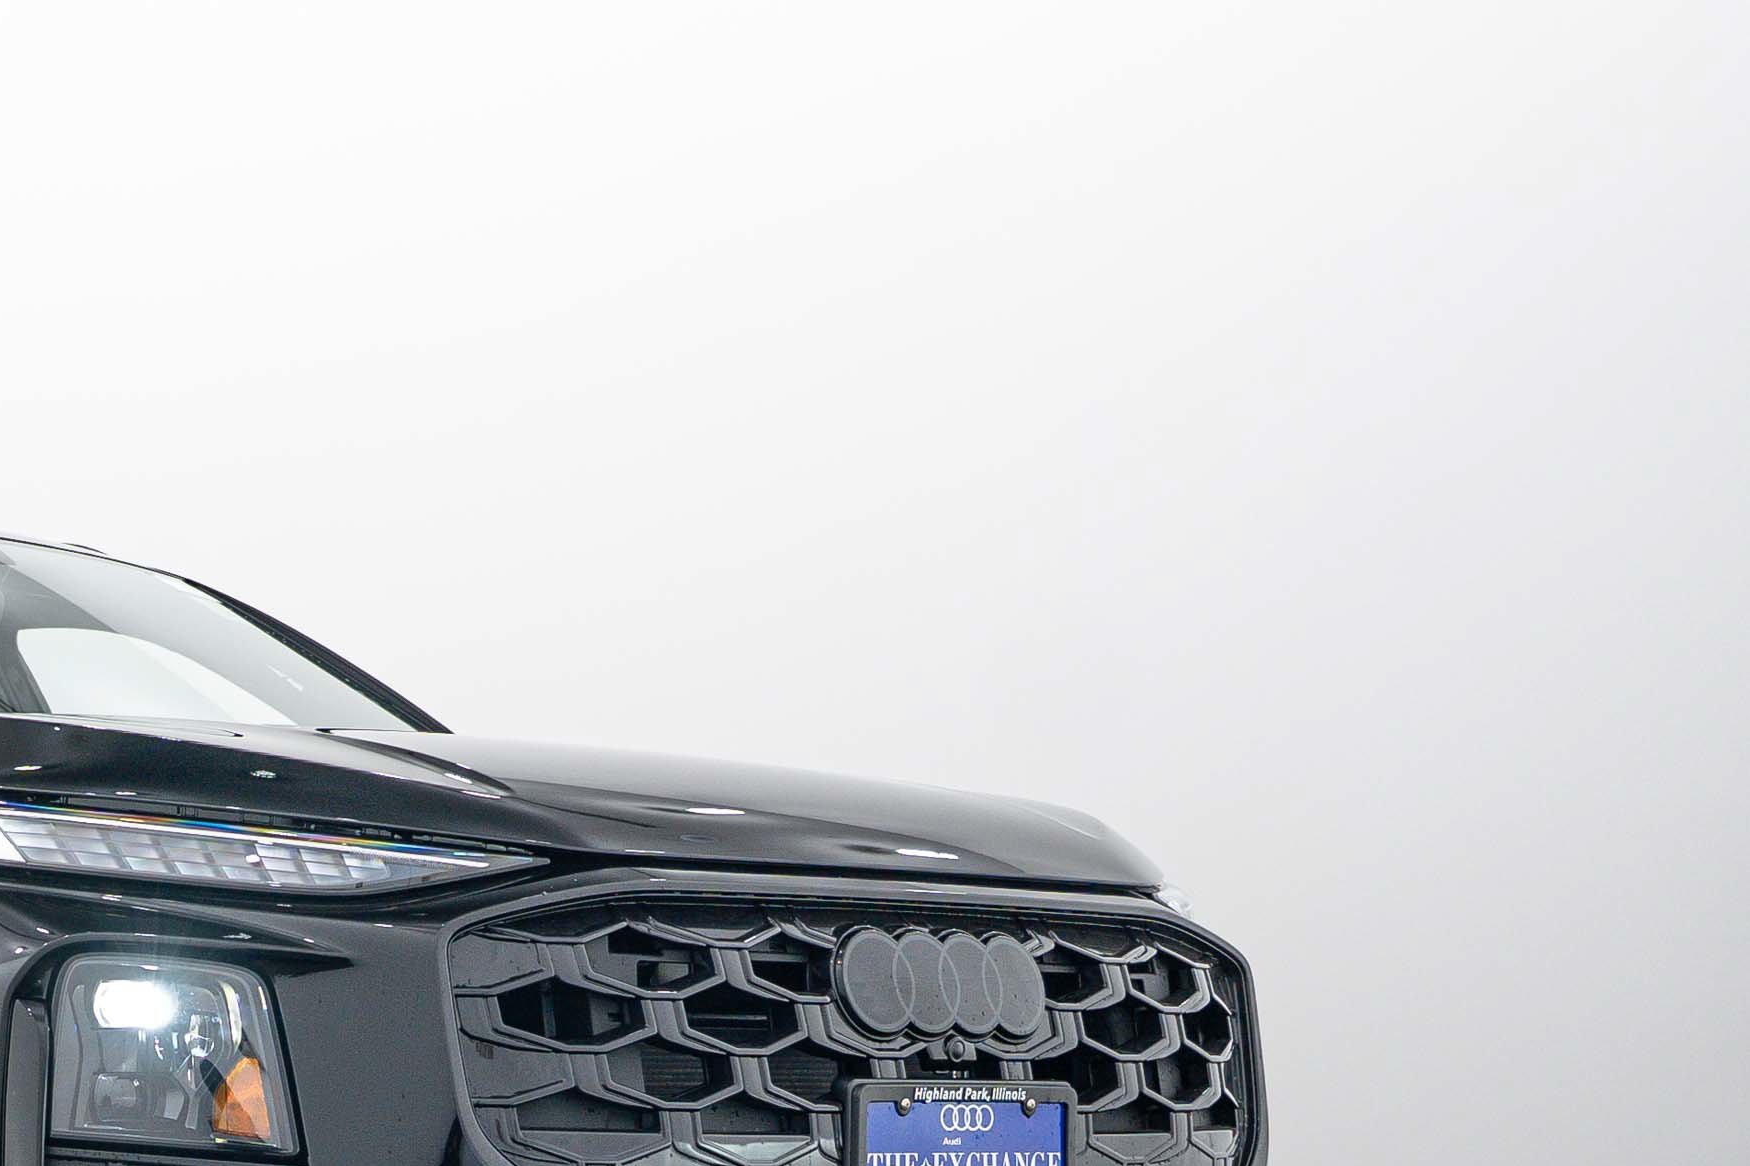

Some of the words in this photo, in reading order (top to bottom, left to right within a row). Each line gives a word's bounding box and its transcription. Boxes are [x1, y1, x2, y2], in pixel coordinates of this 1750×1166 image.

[914, 1087, 962, 1103] Highland
[964, 1087, 990, 1102] Park,
[992, 1088, 1026, 1100] Illinois
[943, 1137, 962, 1145] Audi
